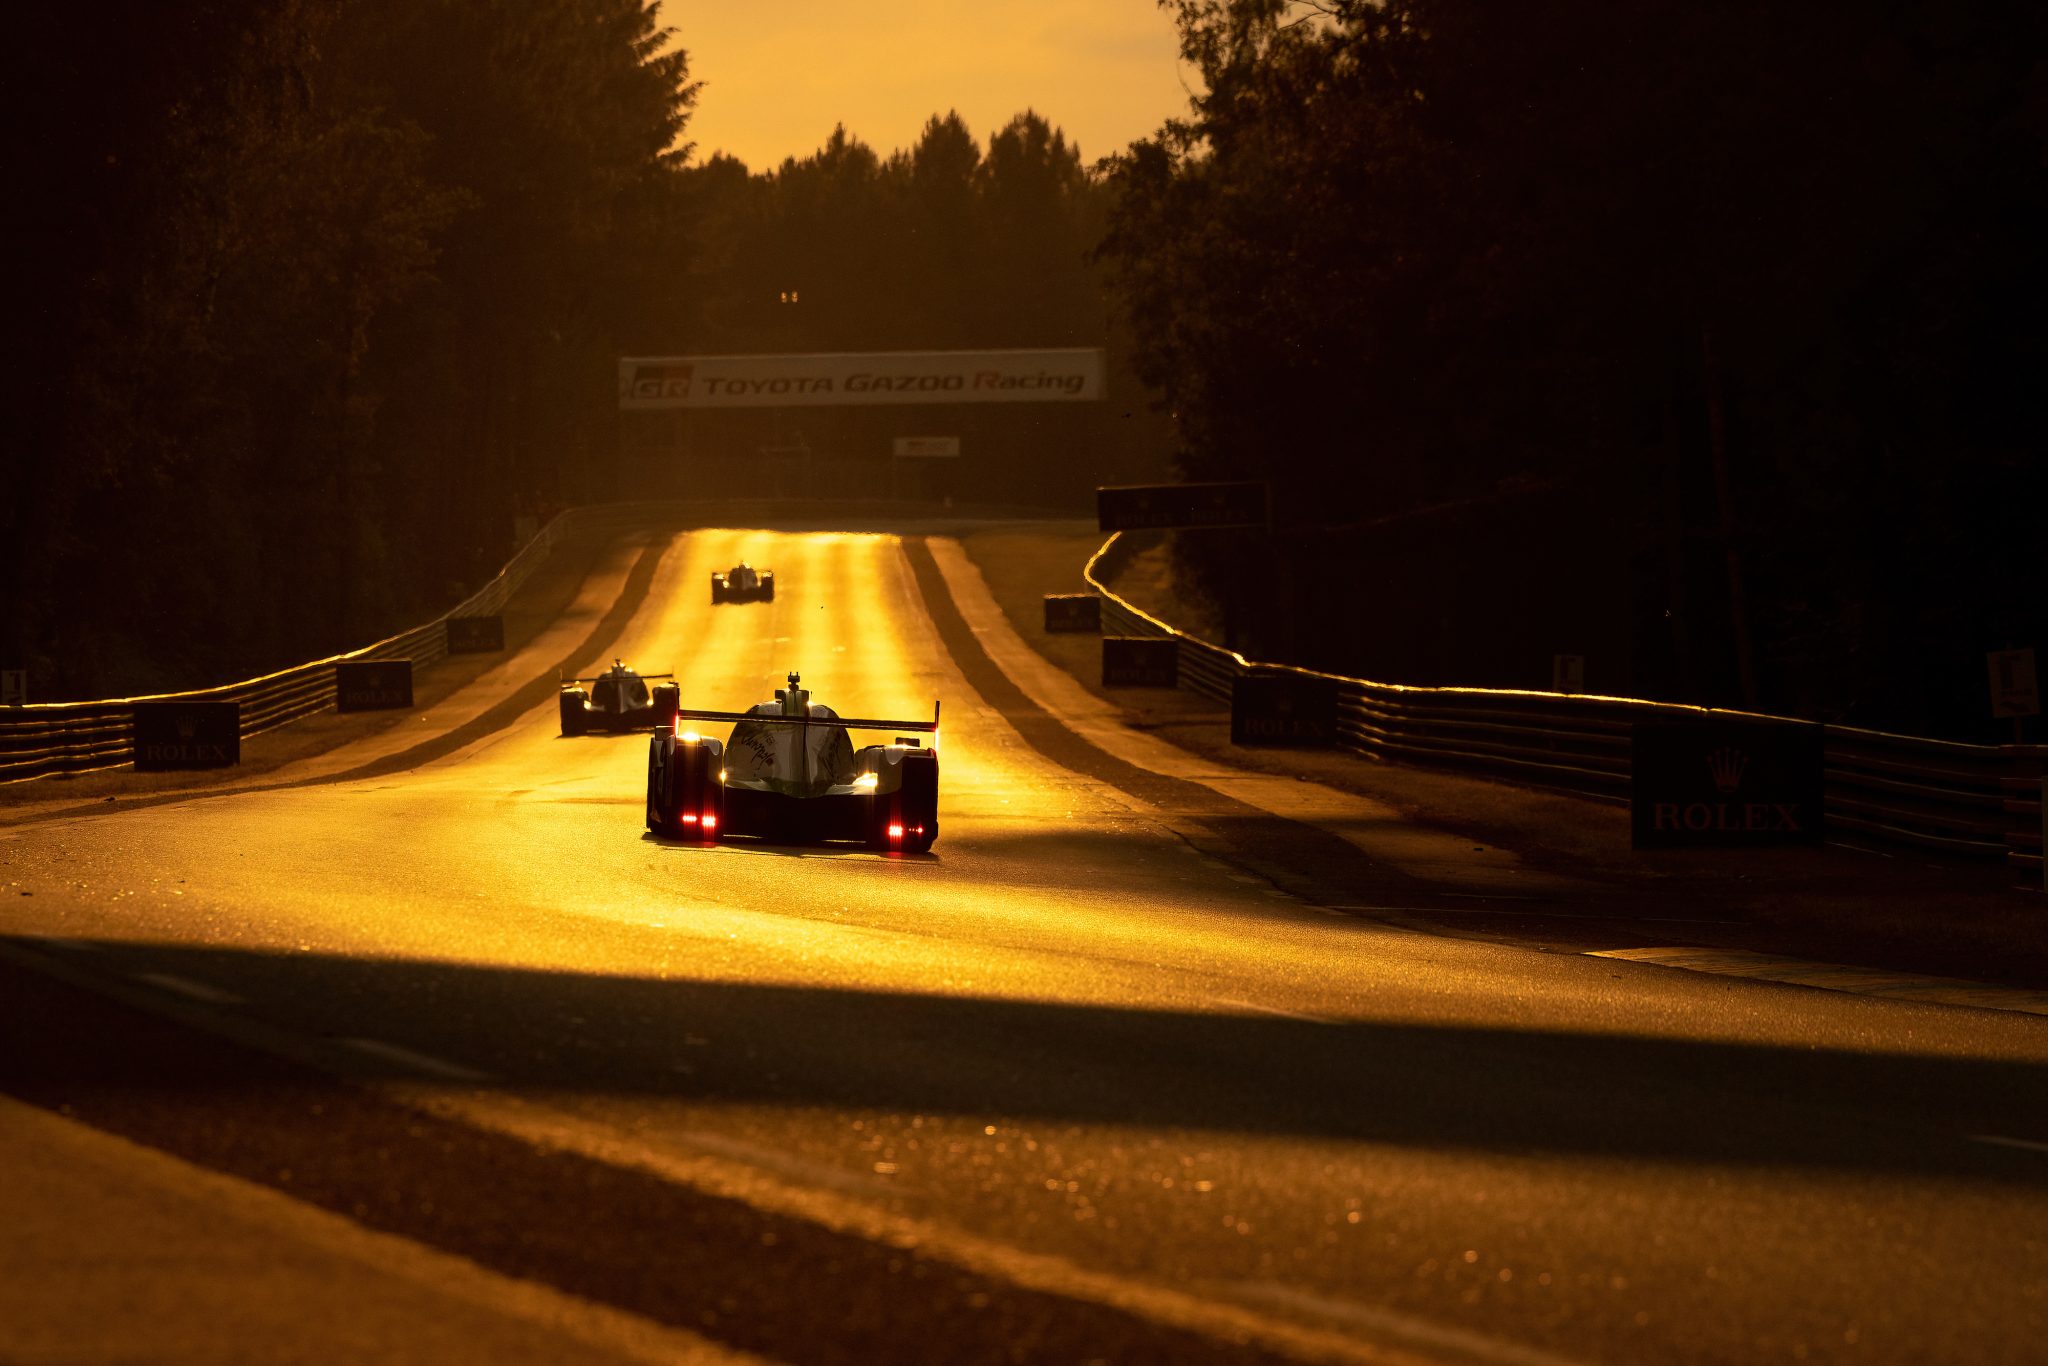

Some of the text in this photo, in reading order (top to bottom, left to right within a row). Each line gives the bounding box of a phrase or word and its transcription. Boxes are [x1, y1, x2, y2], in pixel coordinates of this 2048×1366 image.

[705, 378, 833, 395] TOYOTA
[844, 373, 965, 392] GAZOO
[974, 371, 1086, 394] Racing
[1244, 720, 1326, 737] ROLEX
[147, 745, 226, 761] ROLEX
[1654, 802, 1801, 832] ROLEX
